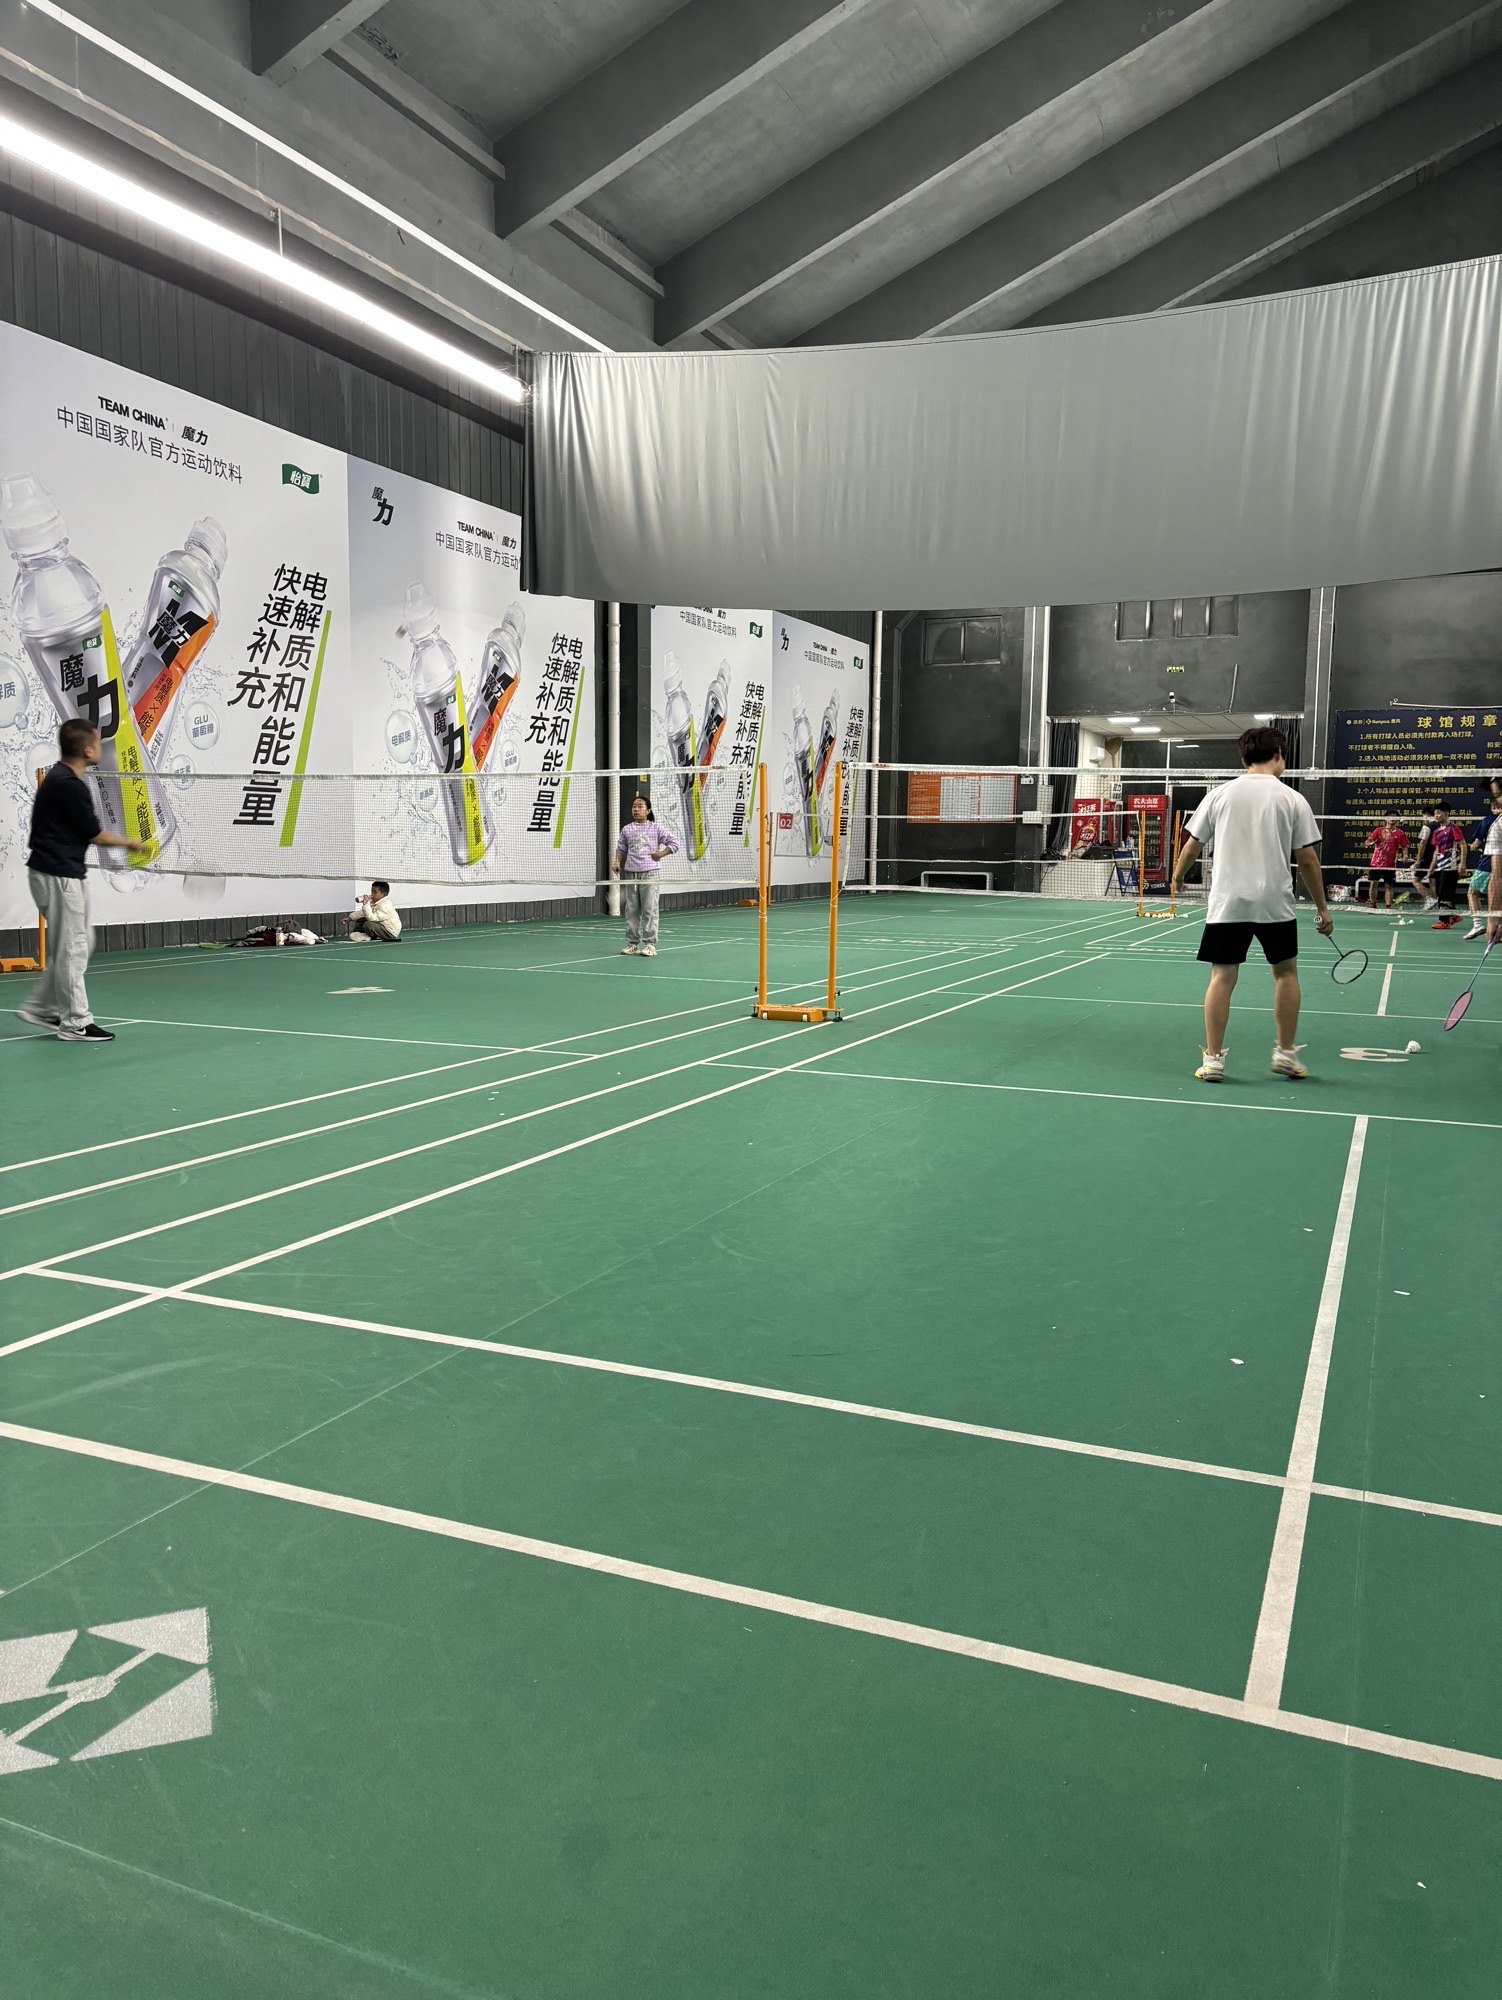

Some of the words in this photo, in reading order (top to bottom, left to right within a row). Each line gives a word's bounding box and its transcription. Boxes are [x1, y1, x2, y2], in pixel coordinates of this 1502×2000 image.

[98, 396, 130, 418] TEAM
[133, 408, 166, 431] CHINA
[57, 406, 243, 485] 中国国家队官方运动饮料
[181, 425, 209, 446] 魔力
[371, 486, 394, 526] 魔力
[457, 521, 475, 535] TEAM
[475, 527, 494, 541] CHINA
[501, 535, 517, 550] 魔力
[435, 530, 522, 570] 中国国家队官方运动
[227, 563, 301, 710] 快速补充
[60, 653, 120, 740] 魔力
[194, 714, 210, 726] GLU
[1417, 714, 1498, 729] 球馆规章
[434, 707, 466, 774] 魔力
[780, 818, 792, 828] 02
